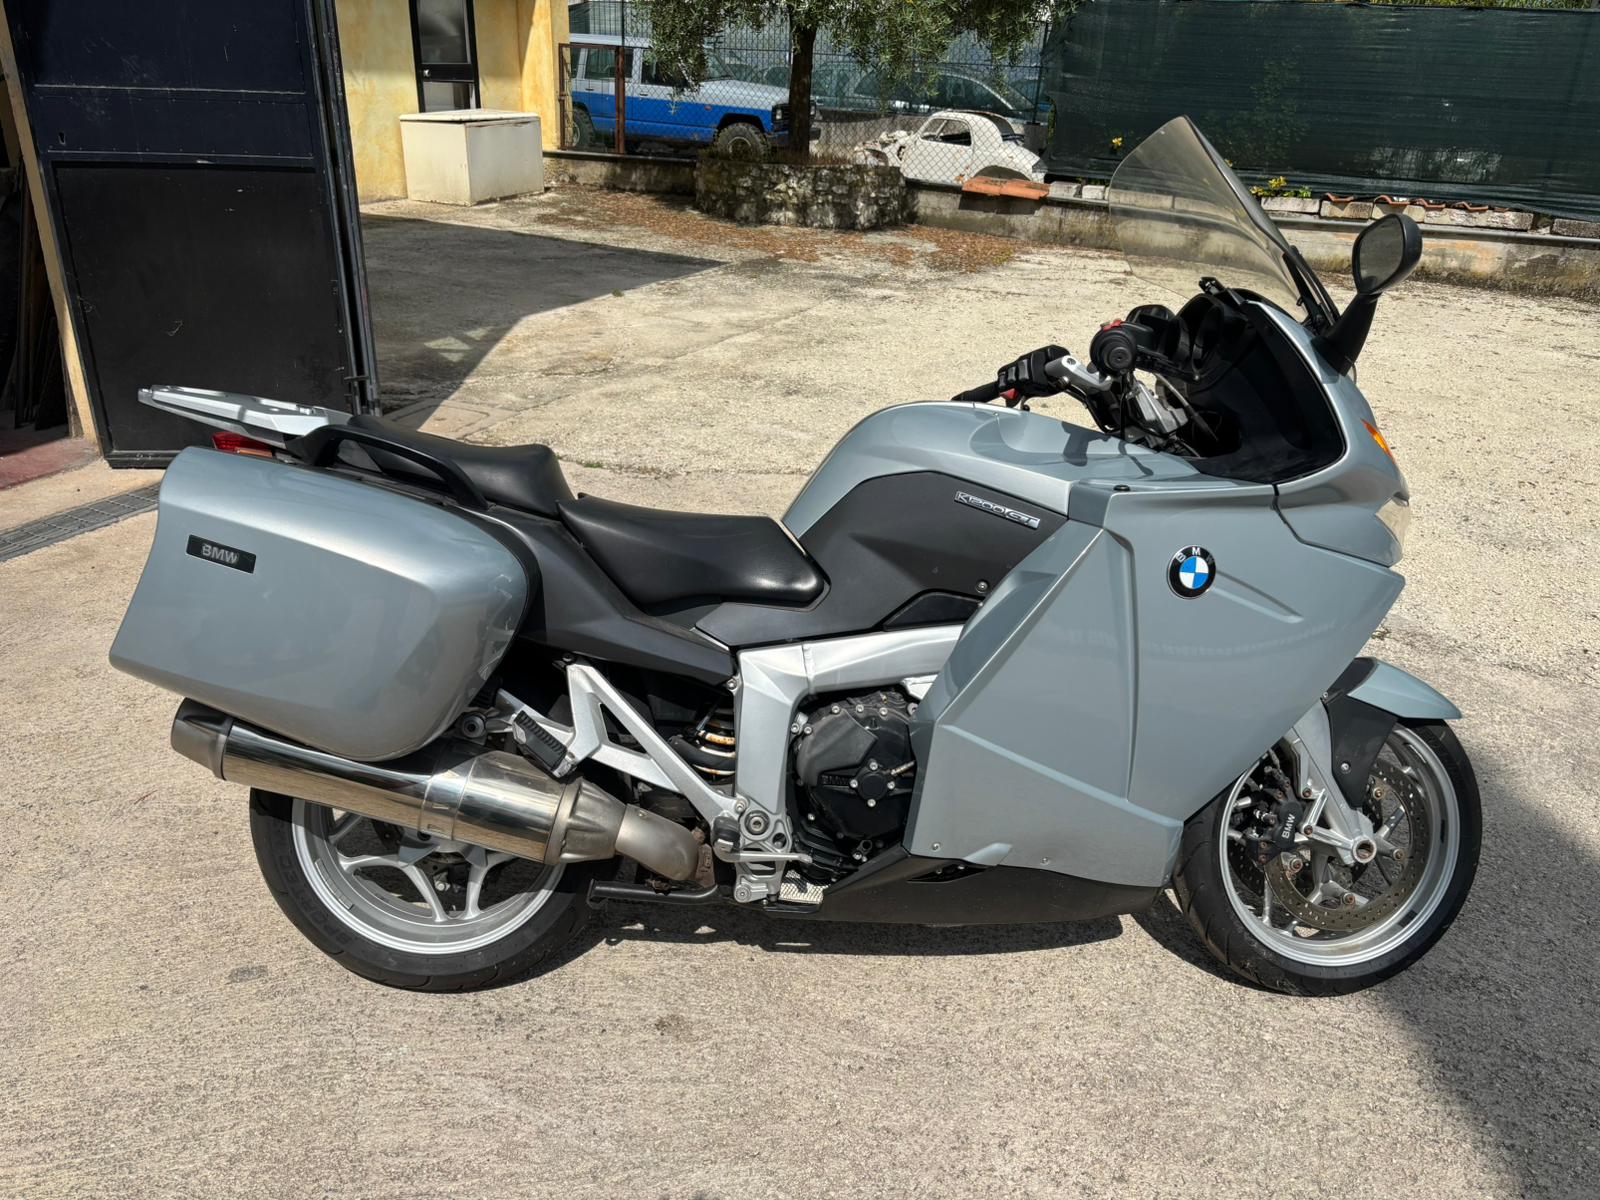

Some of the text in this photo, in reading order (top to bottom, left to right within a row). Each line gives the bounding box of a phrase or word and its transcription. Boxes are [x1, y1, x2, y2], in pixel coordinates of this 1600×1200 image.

[201, 542, 239, 565] BMW
[1175, 546, 1215, 565] BMW
[821, 775, 849, 786] BMW
[1281, 813, 1296, 839] BMW
